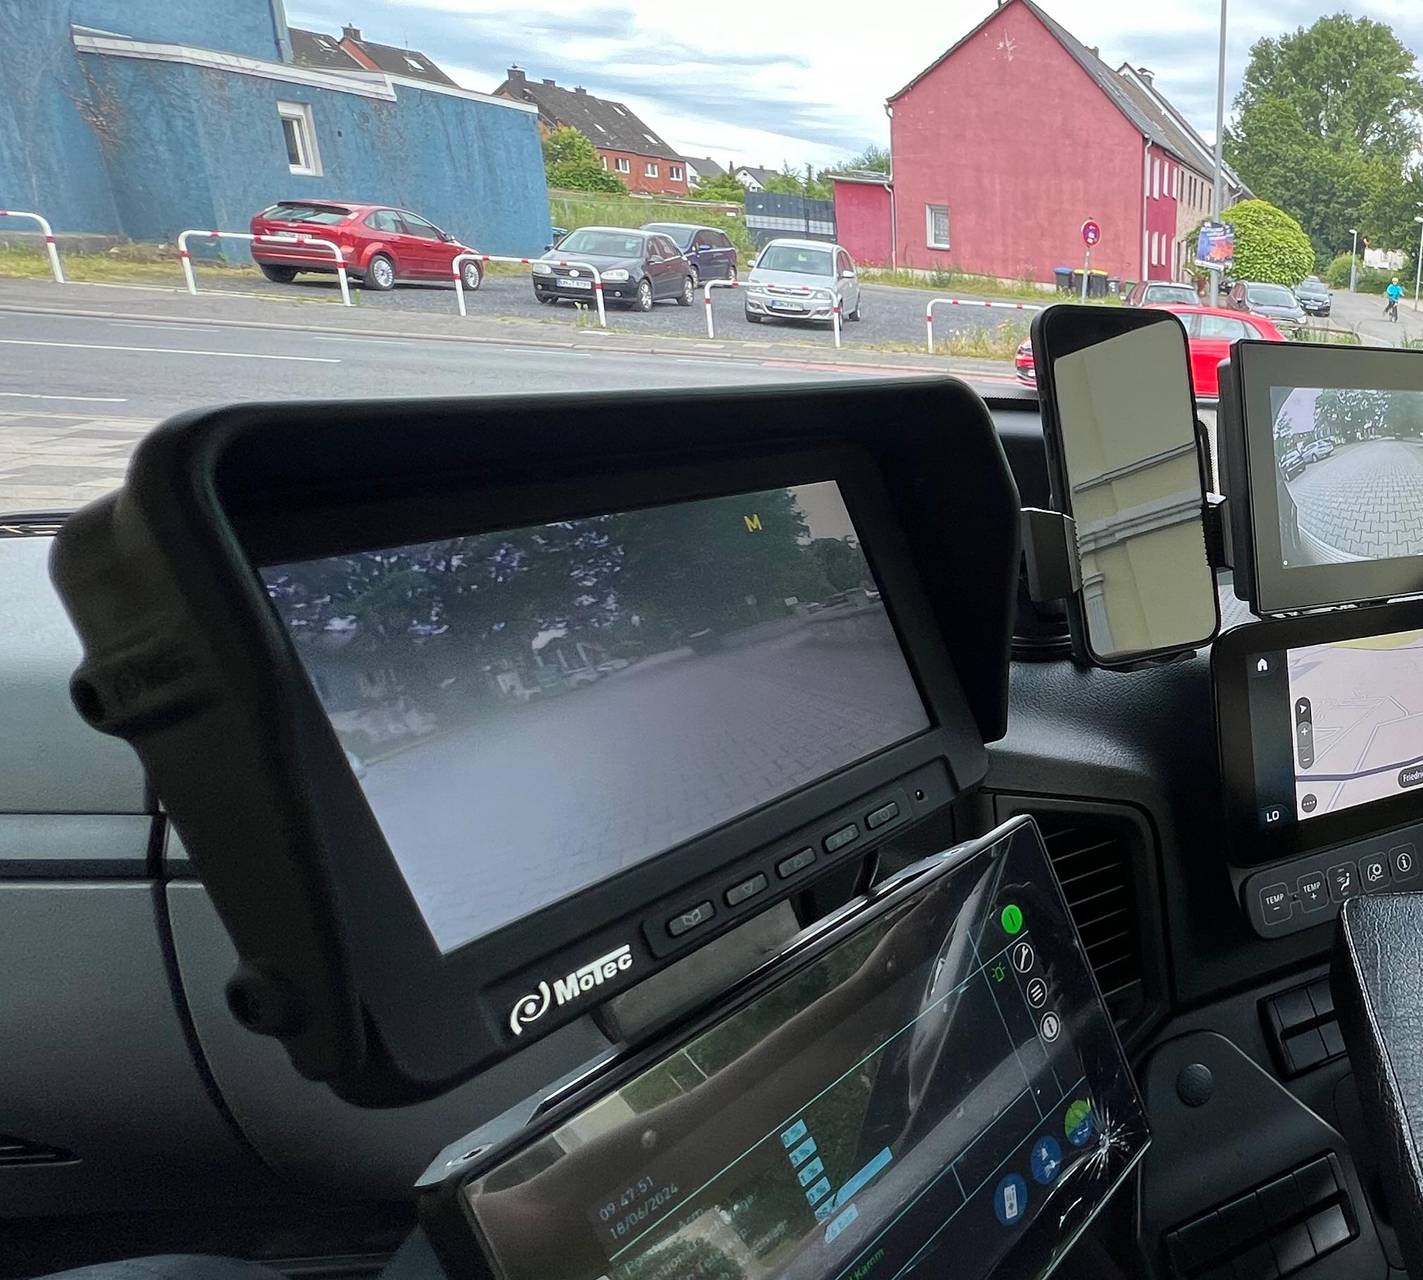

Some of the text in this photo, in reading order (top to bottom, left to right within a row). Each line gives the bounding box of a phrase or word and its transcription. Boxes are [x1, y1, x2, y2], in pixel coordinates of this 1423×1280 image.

[744, 514, 762, 532] M
[1266, 810, 1280, 822] LO
[1303, 881, 1321, 893] TEMP
[1265, 893, 1285, 905] TEMP
[609, 1184, 679, 1240] 18/06/2024
